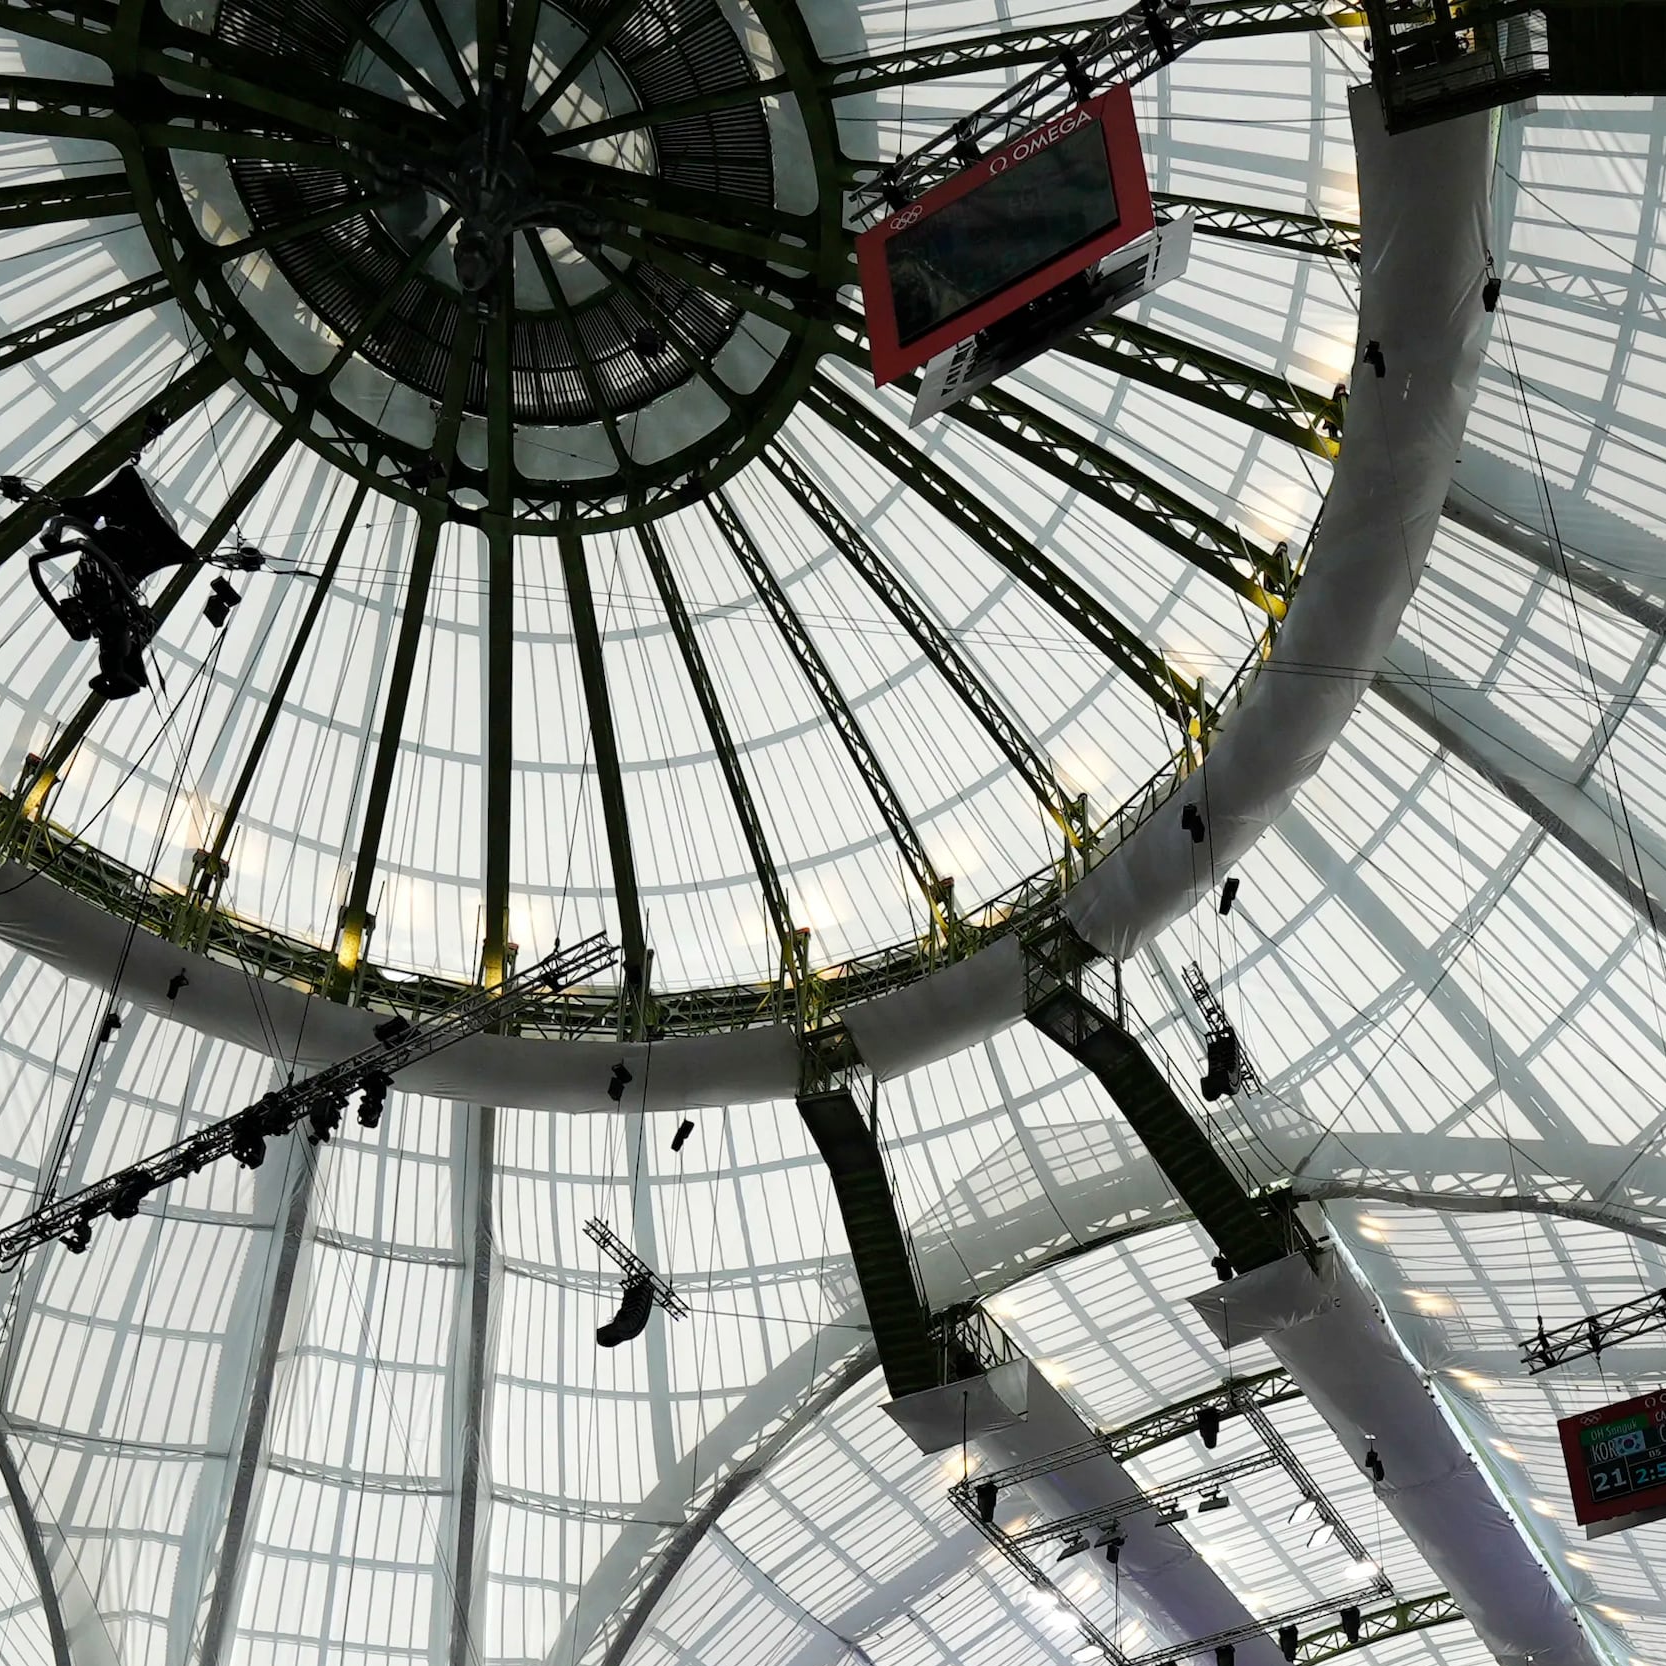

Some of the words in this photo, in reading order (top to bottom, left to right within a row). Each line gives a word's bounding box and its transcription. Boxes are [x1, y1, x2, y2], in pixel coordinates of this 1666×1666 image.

[1013, 110, 1093, 160] OMEGA
[1590, 1429, 1605, 1442] OH
[1591, 1440, 1617, 1464] KOR
[1593, 1467, 1628, 1493] 21
